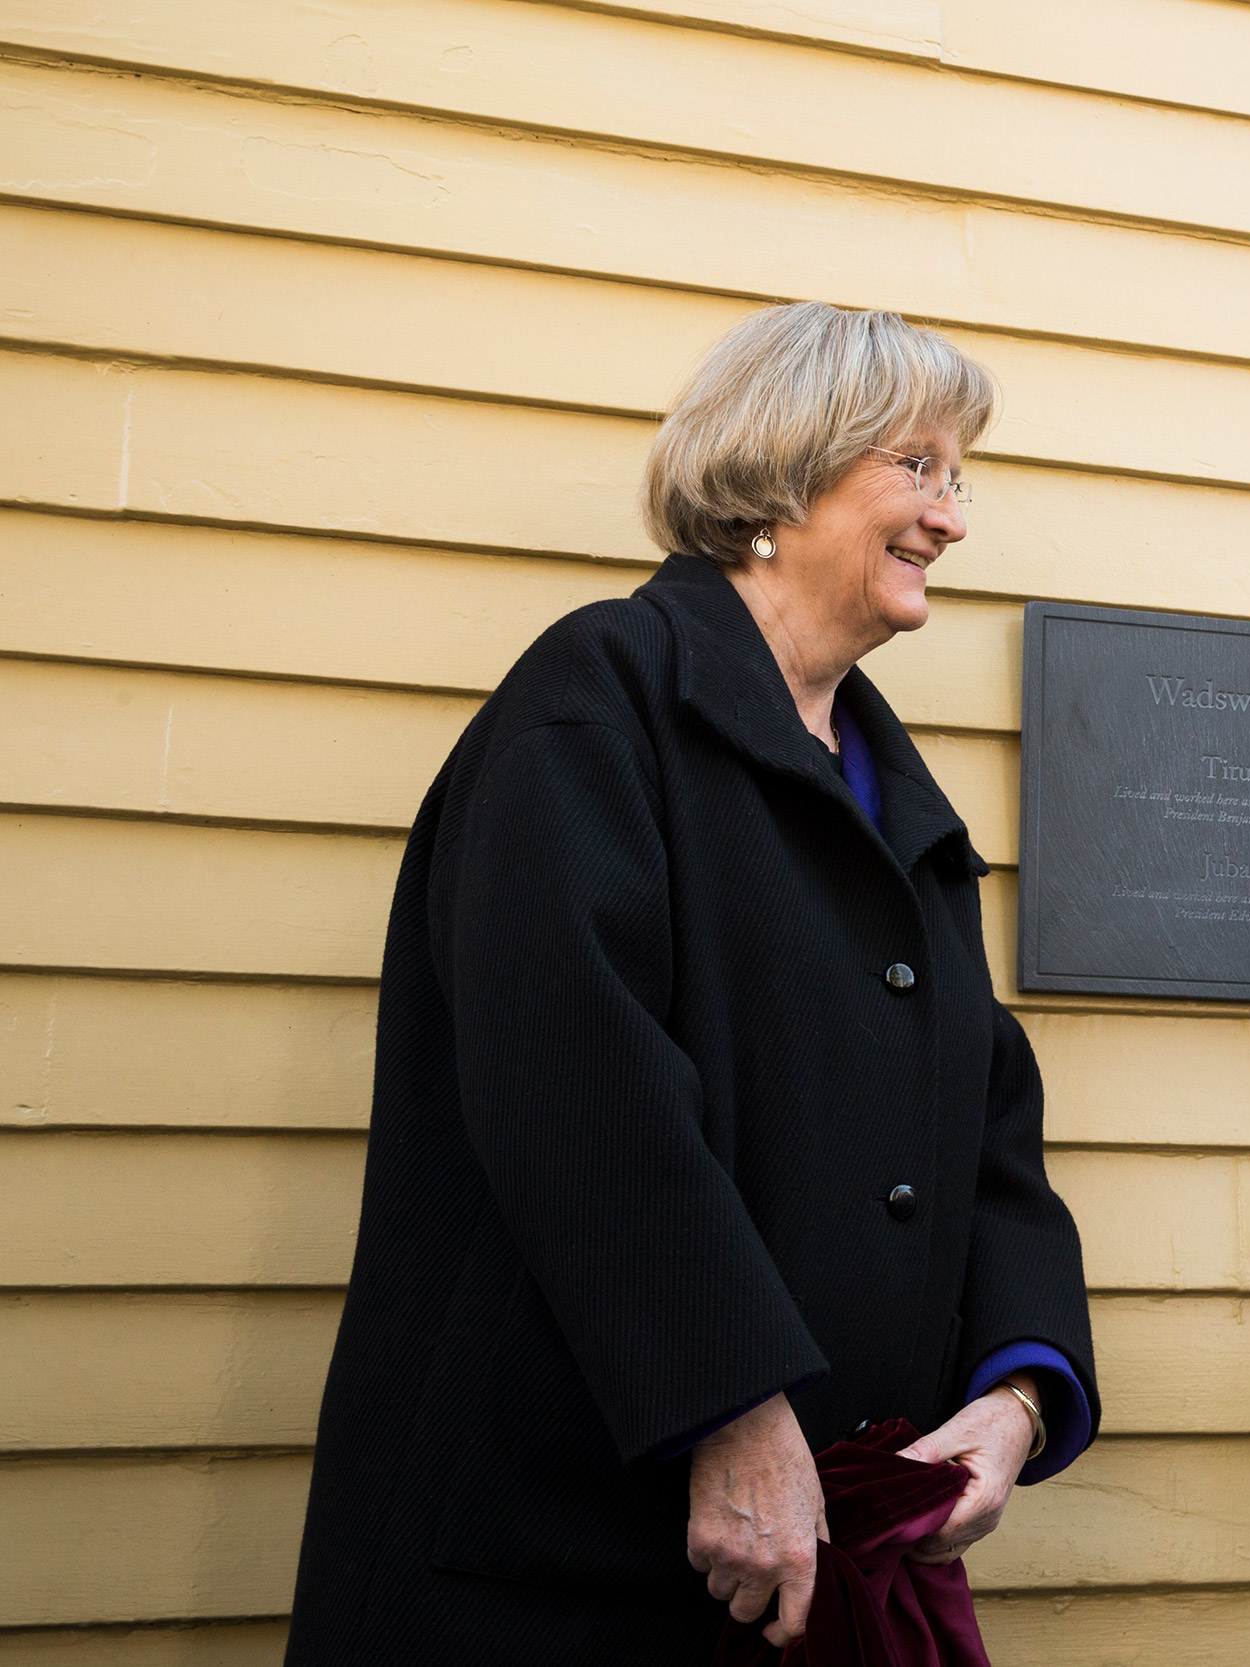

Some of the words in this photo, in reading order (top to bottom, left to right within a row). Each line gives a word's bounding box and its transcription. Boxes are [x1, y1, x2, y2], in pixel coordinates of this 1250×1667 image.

[1113, 786, 1147, 799] Lived
[1150, 790, 1172, 800] and
[1174, 791, 1214, 804] worked
[1216, 794, 1237, 805] here
[1164, 807, 1214, 821] President
[1201, 852, 1250, 882] Juba
[1112, 885, 1146, 898] Lived
[1149, 889, 1169, 899] and
[1173, 891, 1212, 902] worked
[1216, 893, 1237, 904] here
[1241, 896, 1250, 904] as
[1175, 905, 1225, 920] President
